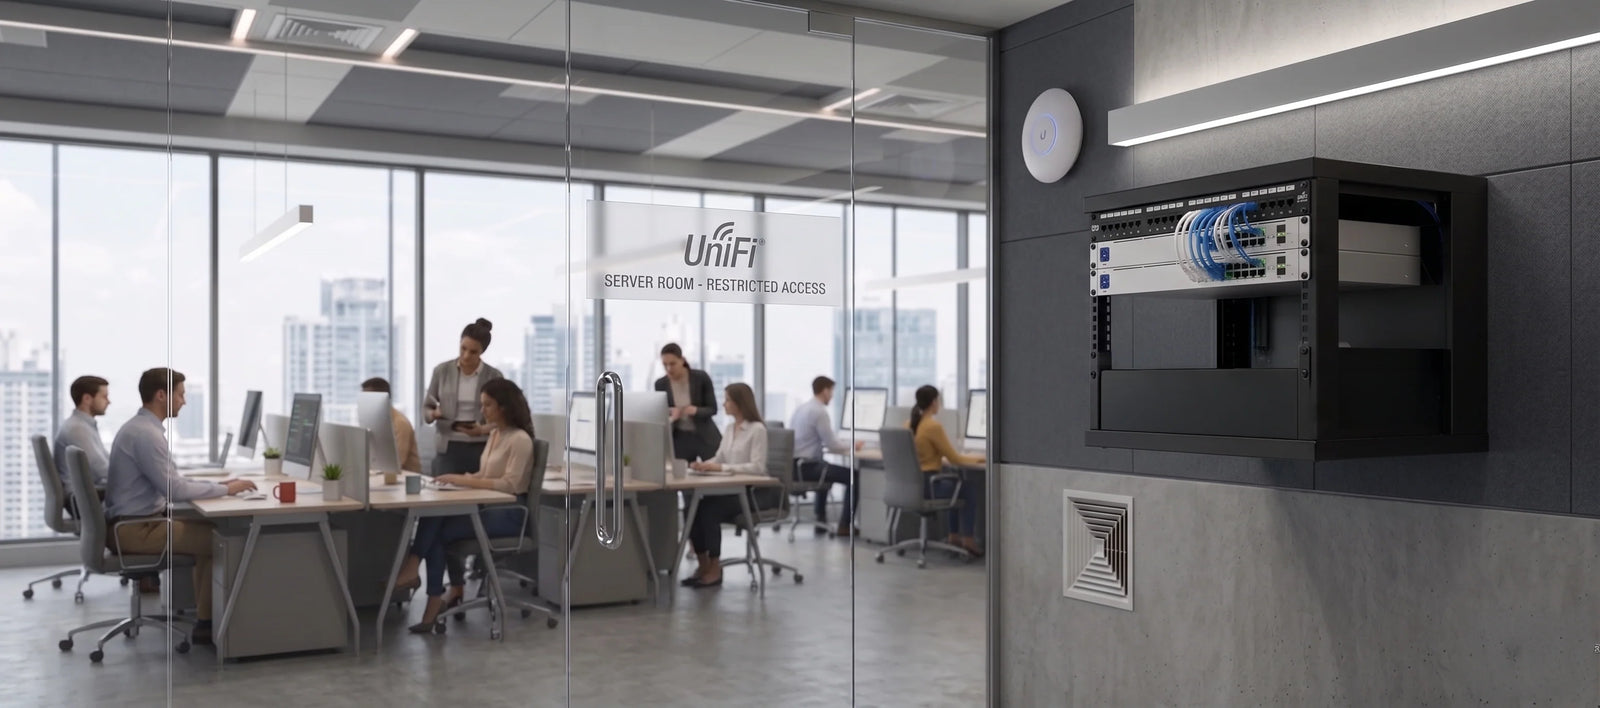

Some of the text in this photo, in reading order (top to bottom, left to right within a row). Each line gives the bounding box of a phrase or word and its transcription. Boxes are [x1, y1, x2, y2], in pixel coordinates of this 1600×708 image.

[604, 274, 654, 288] SERVER
[657, 276, 694, 290] ROOM
[706, 278, 778, 293] RESTRICTED
[781, 281, 826, 295] ACCESS
